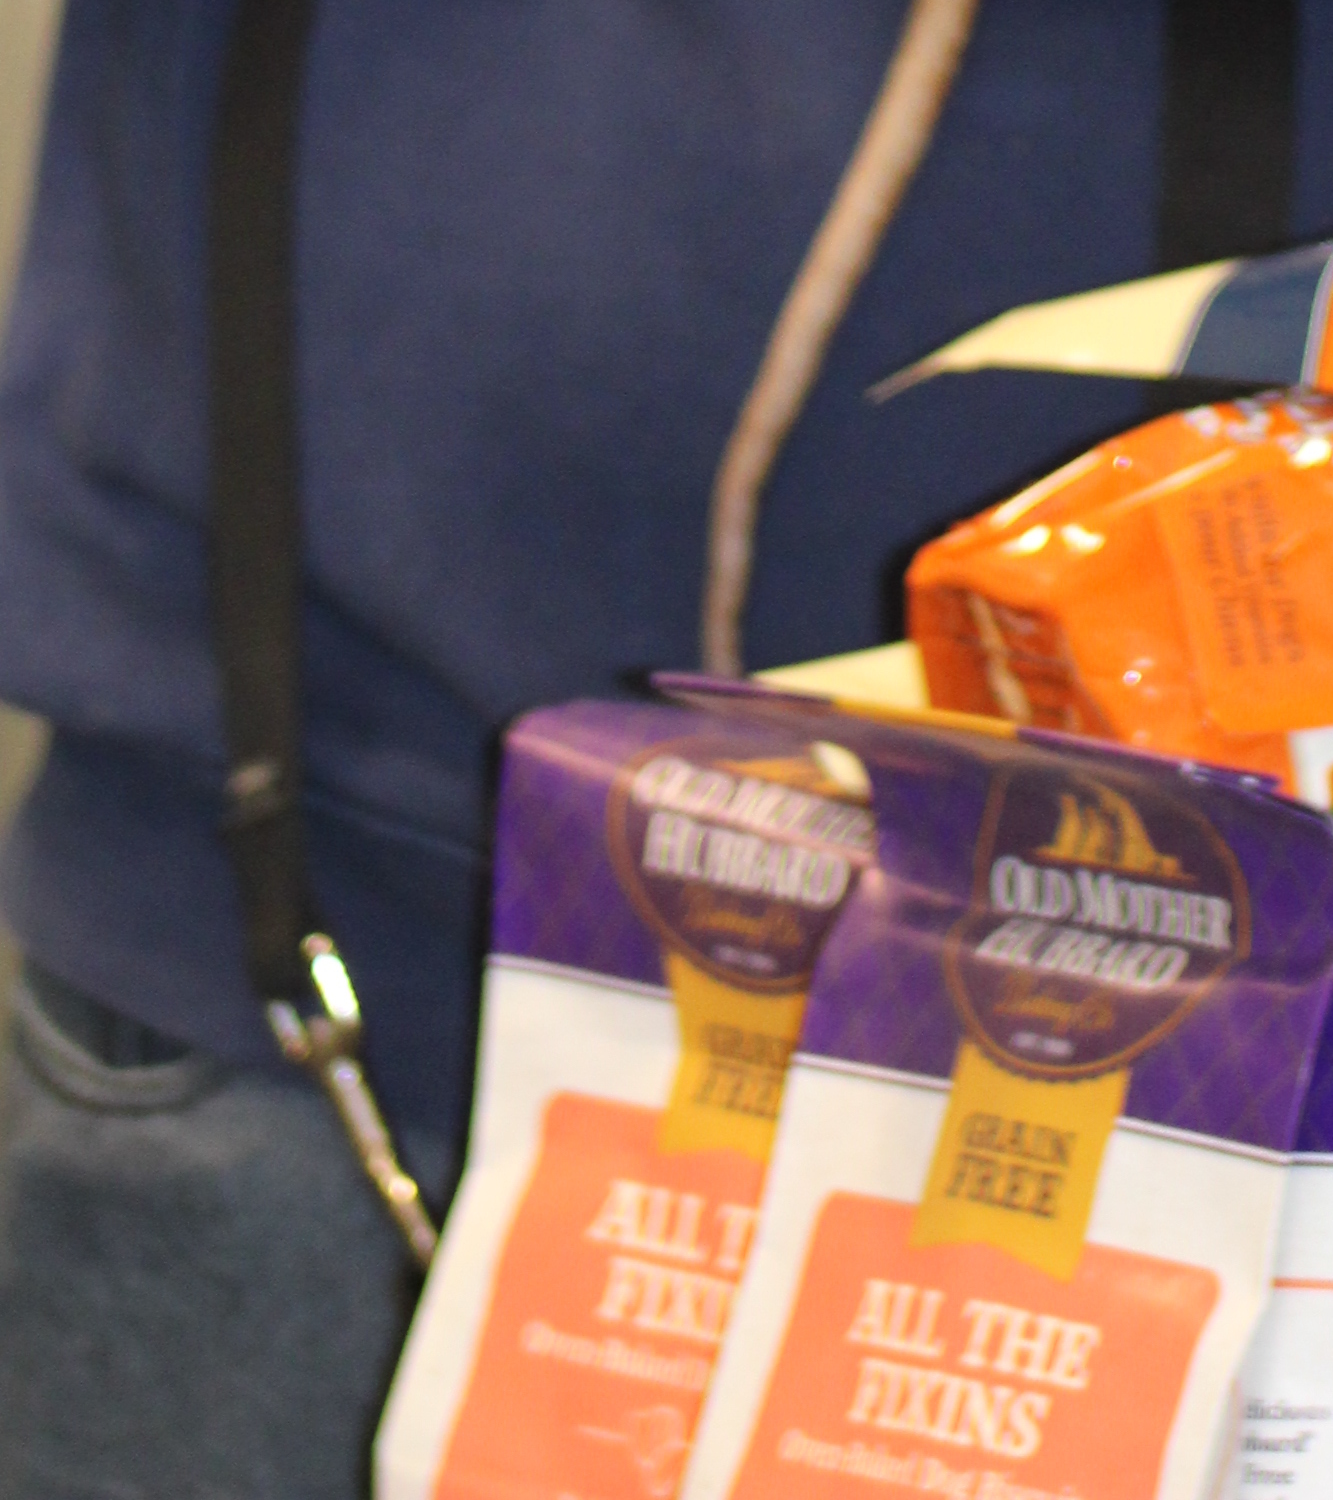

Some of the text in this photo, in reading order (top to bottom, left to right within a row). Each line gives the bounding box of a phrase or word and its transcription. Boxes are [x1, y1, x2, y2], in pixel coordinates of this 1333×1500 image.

[990, 855, 1232, 949] OLD MOTHER
[962, 1111, 1078, 1167] GRAIN
[586, 1178, 708, 1263] ALL
[945, 1152, 1066, 1220] FREE
[595, 1256, 740, 1345] FIXI
[846, 1277, 1103, 1391] ALL THE
[846, 1357, 1052, 1461] FIXINS
